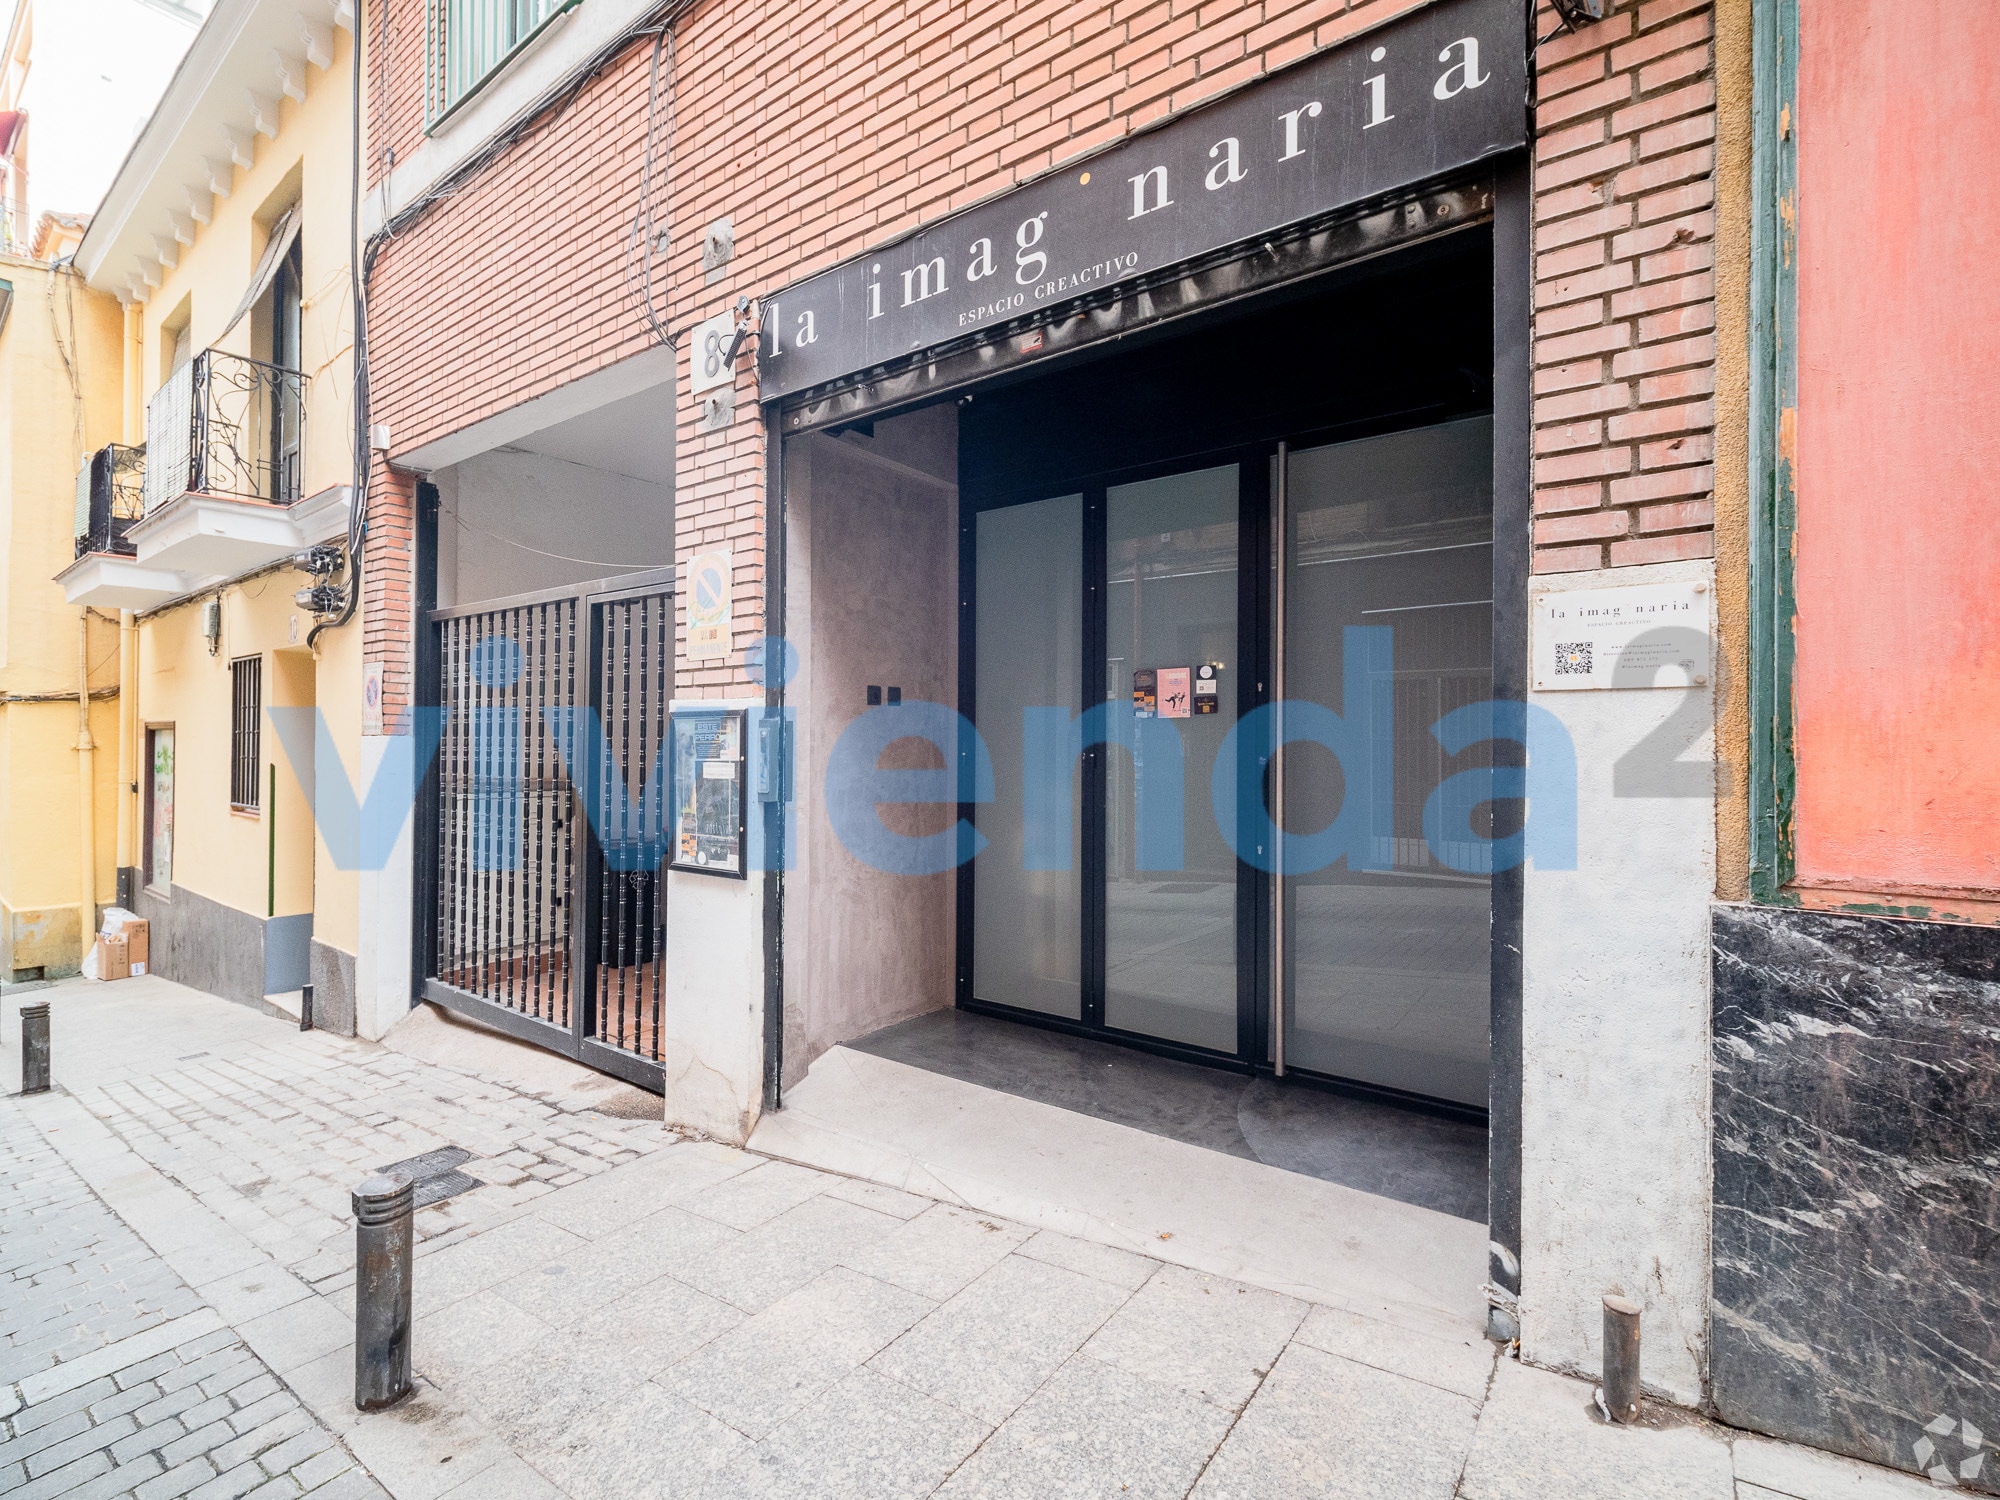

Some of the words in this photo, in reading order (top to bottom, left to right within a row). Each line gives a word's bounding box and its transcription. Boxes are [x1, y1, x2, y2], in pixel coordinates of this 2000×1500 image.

[958, 293, 1025, 327] ESPACIO
[1034, 251, 1139, 300] CREACTIVO
[769, 302, 819, 358] la
[704, 329, 720, 378] 8
[289, 618, 298, 640] 10
[1551, 608, 1565, 619] la
[697, 723, 718, 731] ESTE
